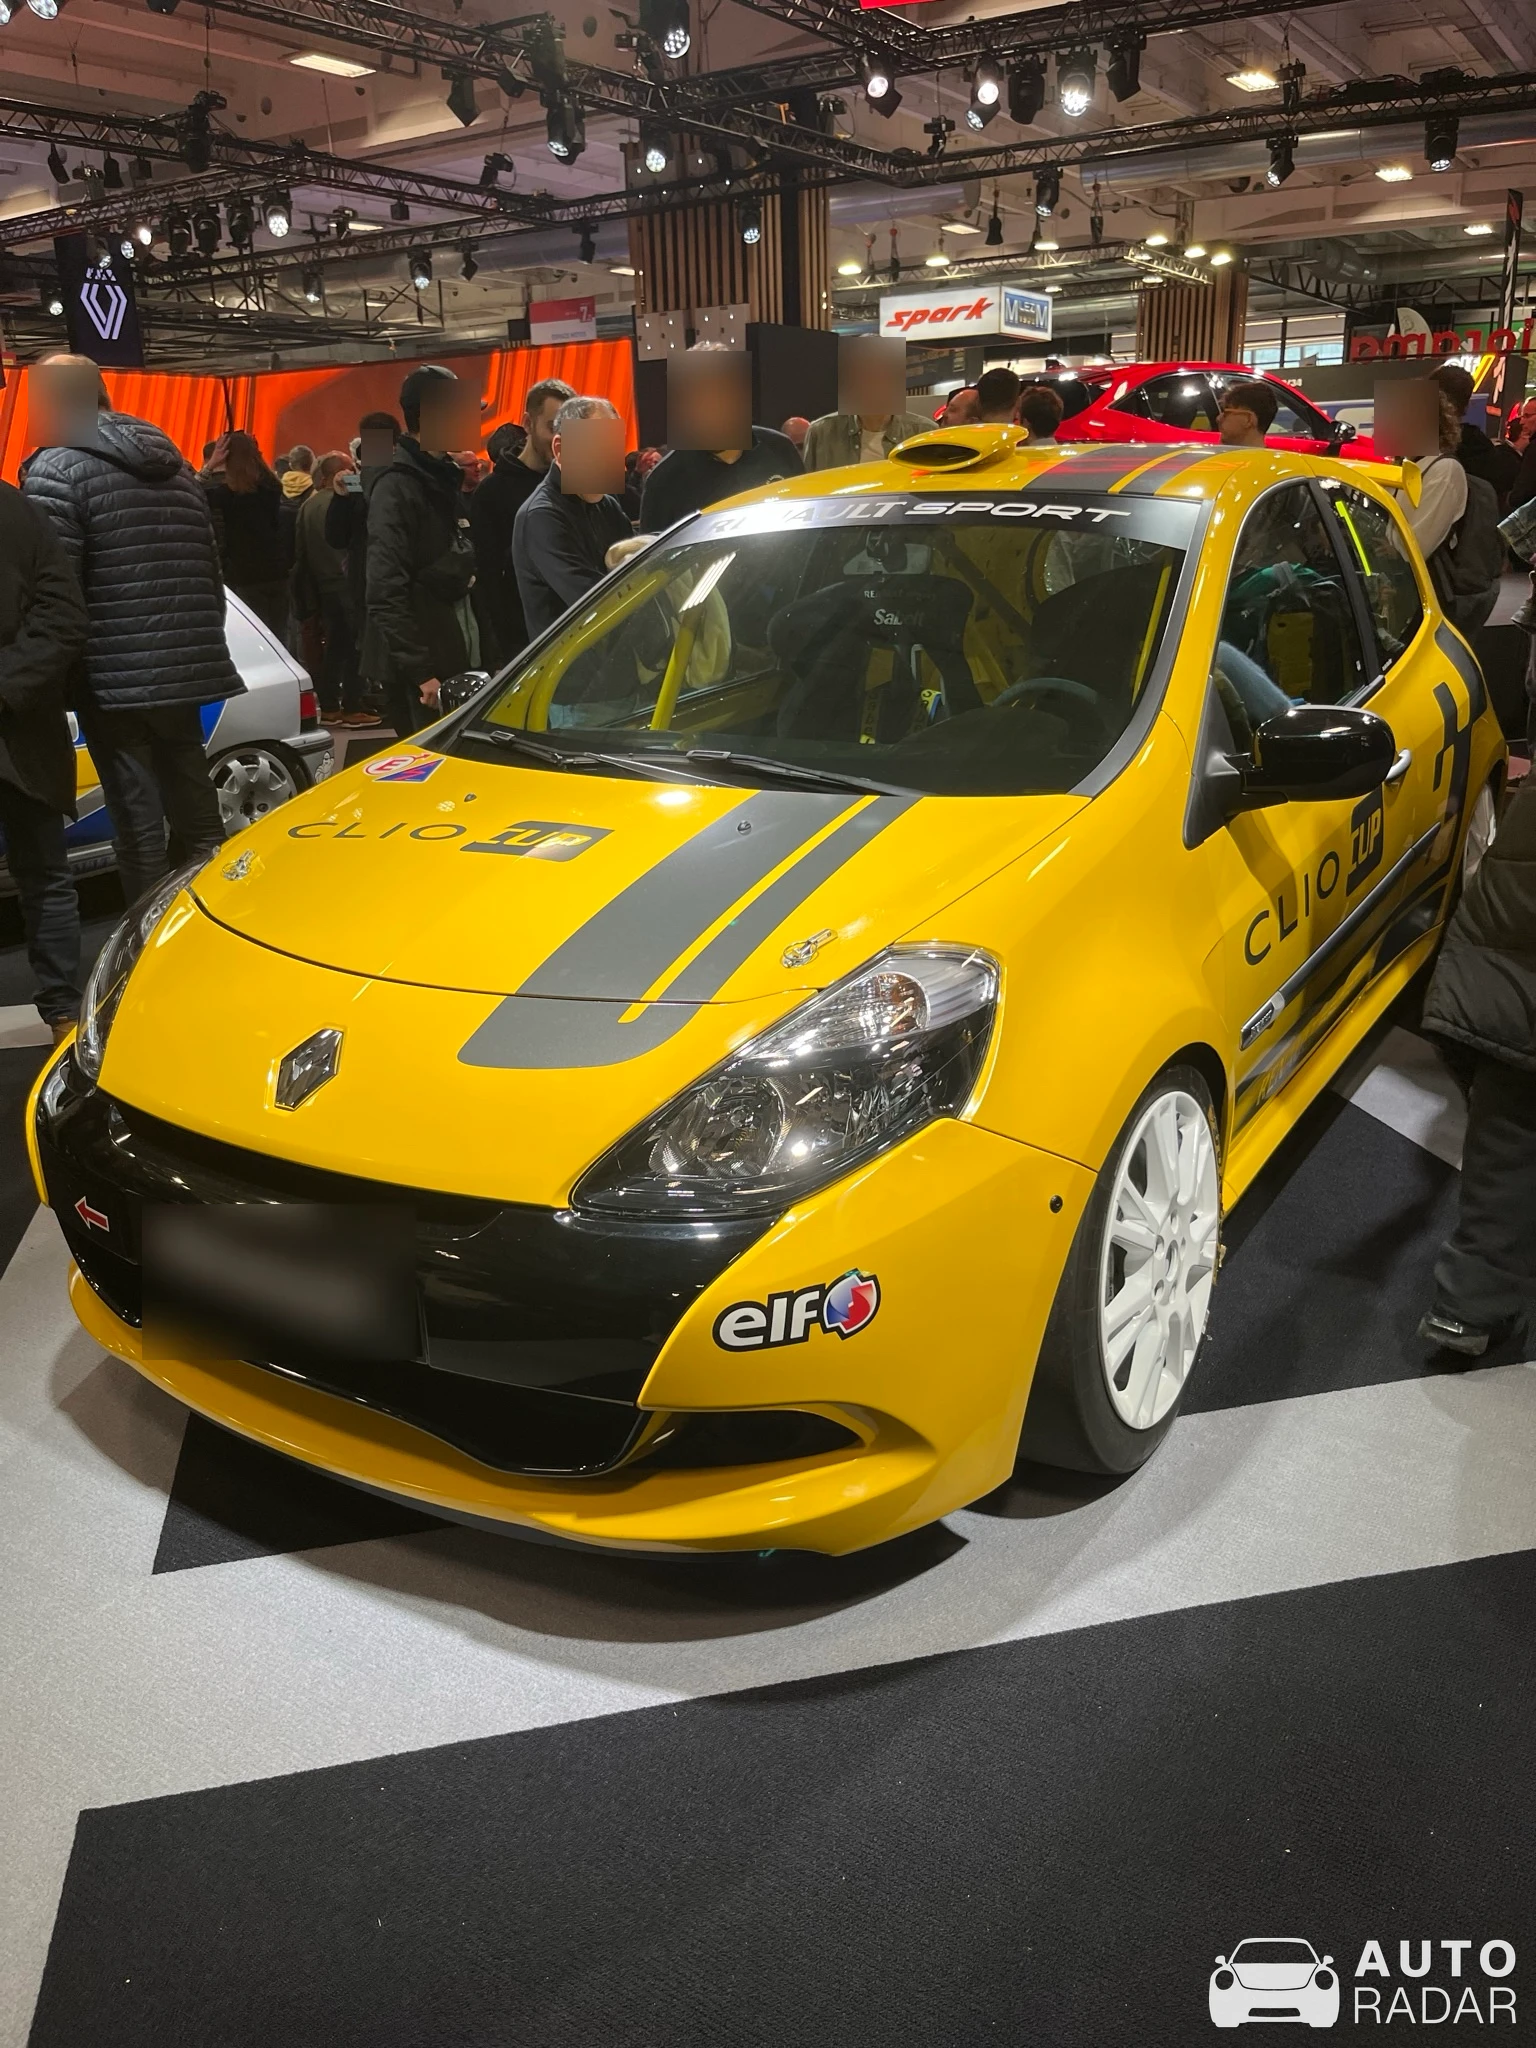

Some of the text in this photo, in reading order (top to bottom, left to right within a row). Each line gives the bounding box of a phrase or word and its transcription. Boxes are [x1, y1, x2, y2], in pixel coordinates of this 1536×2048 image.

[886, 297, 994, 332] spark
[904, 502, 1132, 523] SPORT
[287, 821, 468, 841] CLIO
[1244, 850, 1340, 966] CLIO
[717, 1289, 821, 1348] elf
